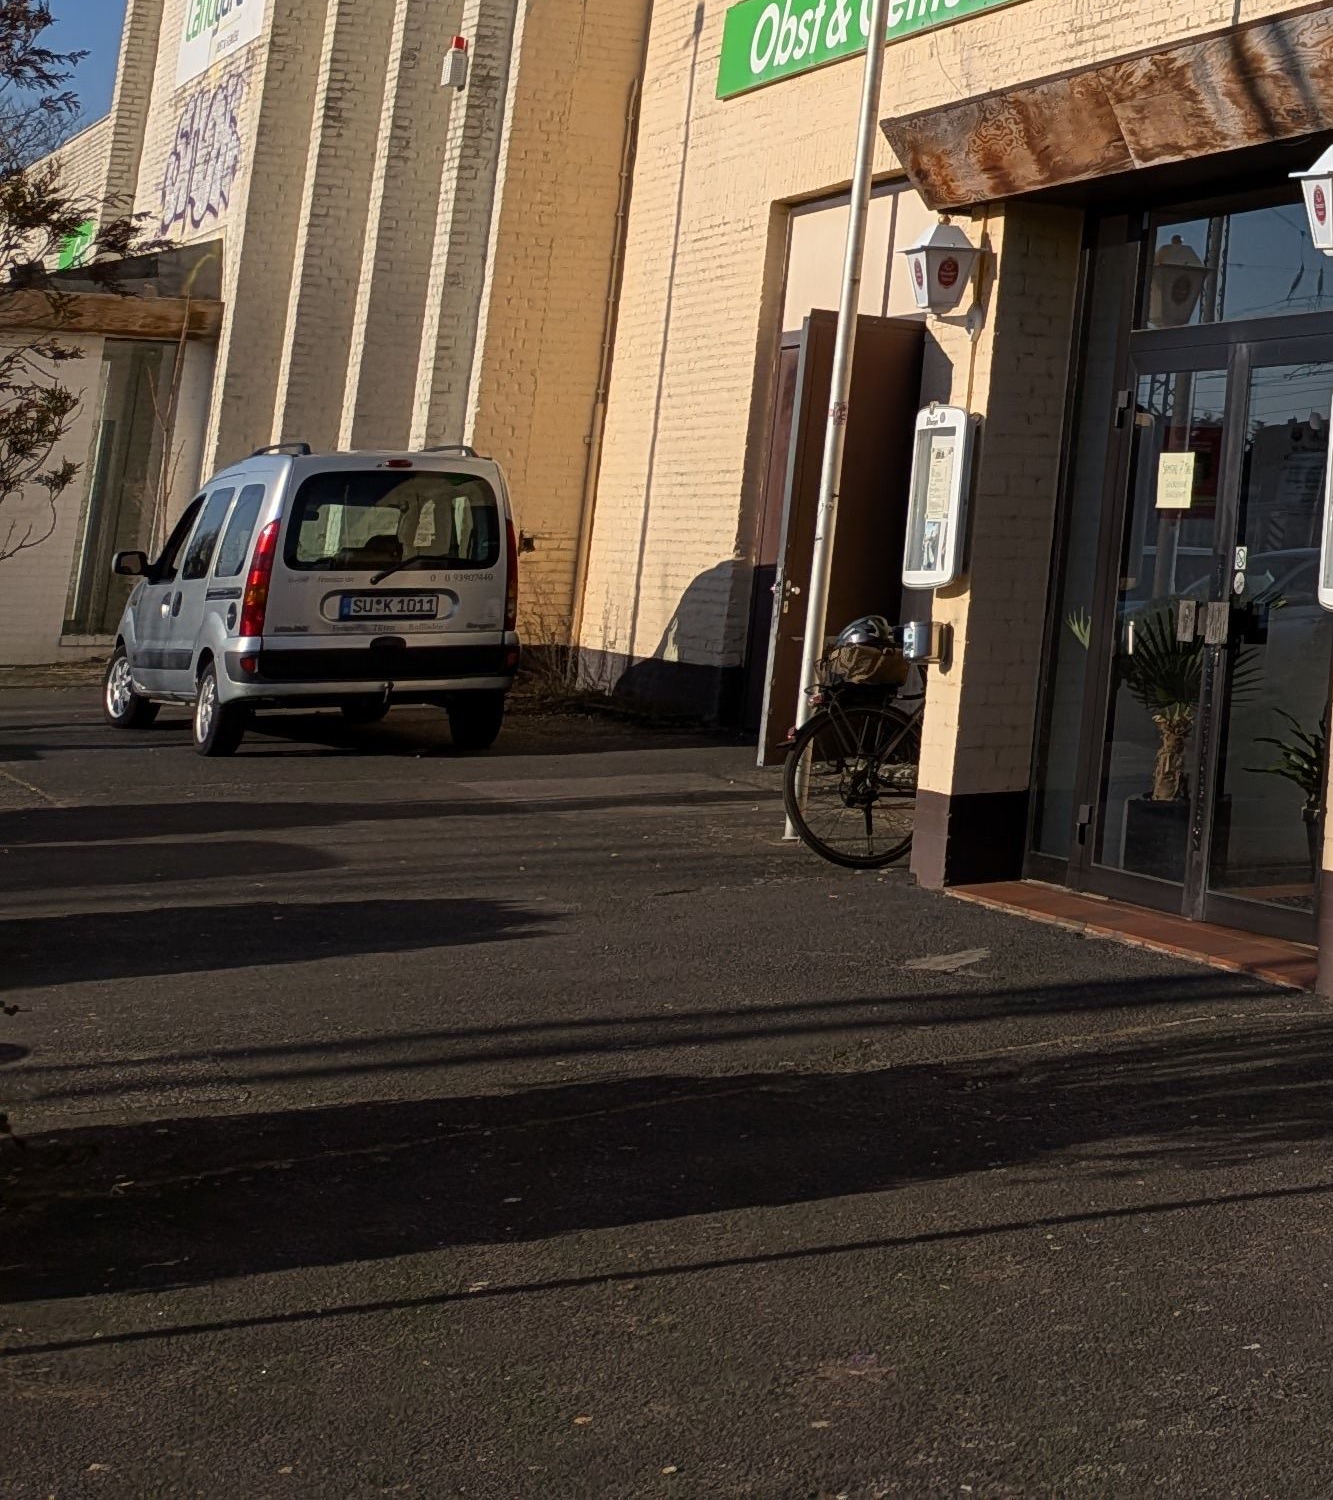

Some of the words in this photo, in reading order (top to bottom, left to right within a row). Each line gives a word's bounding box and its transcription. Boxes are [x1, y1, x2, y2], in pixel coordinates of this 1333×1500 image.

[352, 598, 374, 613] SU
[383, 598, 393, 613] K
[397, 597, 435, 613] 1011
